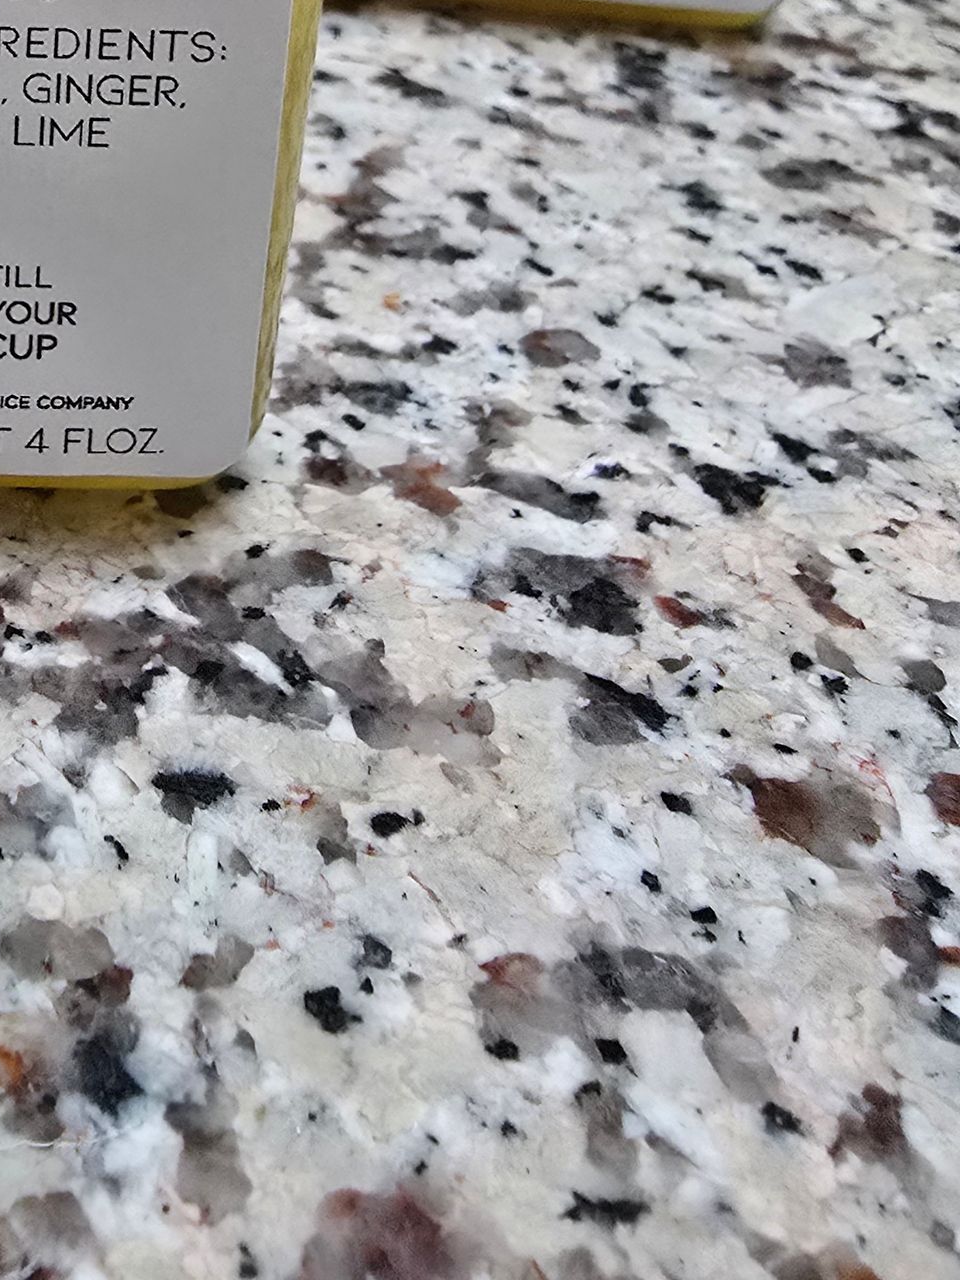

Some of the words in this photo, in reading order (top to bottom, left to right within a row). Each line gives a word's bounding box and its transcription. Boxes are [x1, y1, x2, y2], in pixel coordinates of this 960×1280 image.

[23, 72, 187, 110] GINGER,
[14, 115, 110, 148] LIME
[36, 394, 135, 411] COMPANY
[25, 428, 50, 454] 4
[63, 427, 165, 455] FLOZ.
